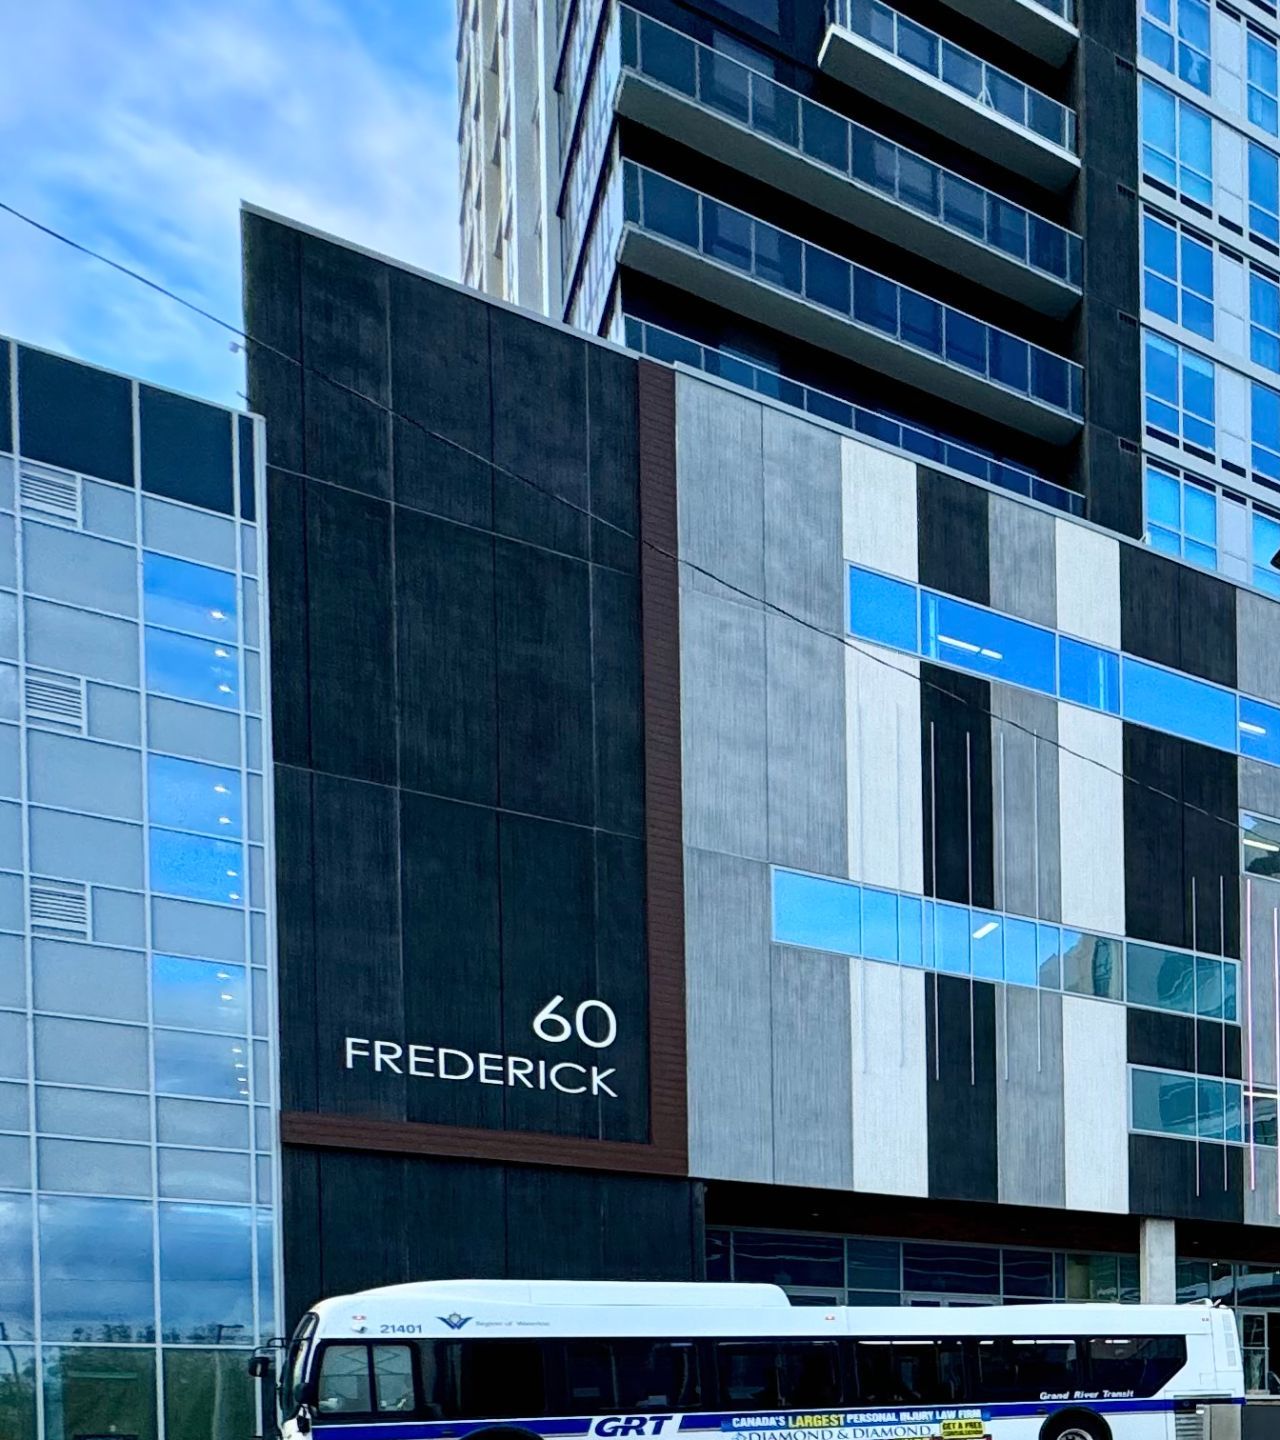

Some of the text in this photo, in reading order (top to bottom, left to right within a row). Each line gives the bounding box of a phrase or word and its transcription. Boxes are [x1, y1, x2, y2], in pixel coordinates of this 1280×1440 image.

[533, 995, 617, 1048] 60
[345, 1037, 618, 1098] FREDERICK
[380, 1324, 423, 1335] 21401
[1040, 1389, 1134, 1400] Grand River Transit
[595, 1415, 673, 1437] GRT
[732, 1416, 786, 1428] CANADA'S
[788, 1414, 846, 1428] LARGEST
[846, 1412, 899, 1424] PERSONAL
[935, 1409, 957, 1420] LAW
[958, 1408, 982, 1420] FIRM
[837, 1430, 849, 1440] &
[853, 1425, 932, 1439] DIAMOND
